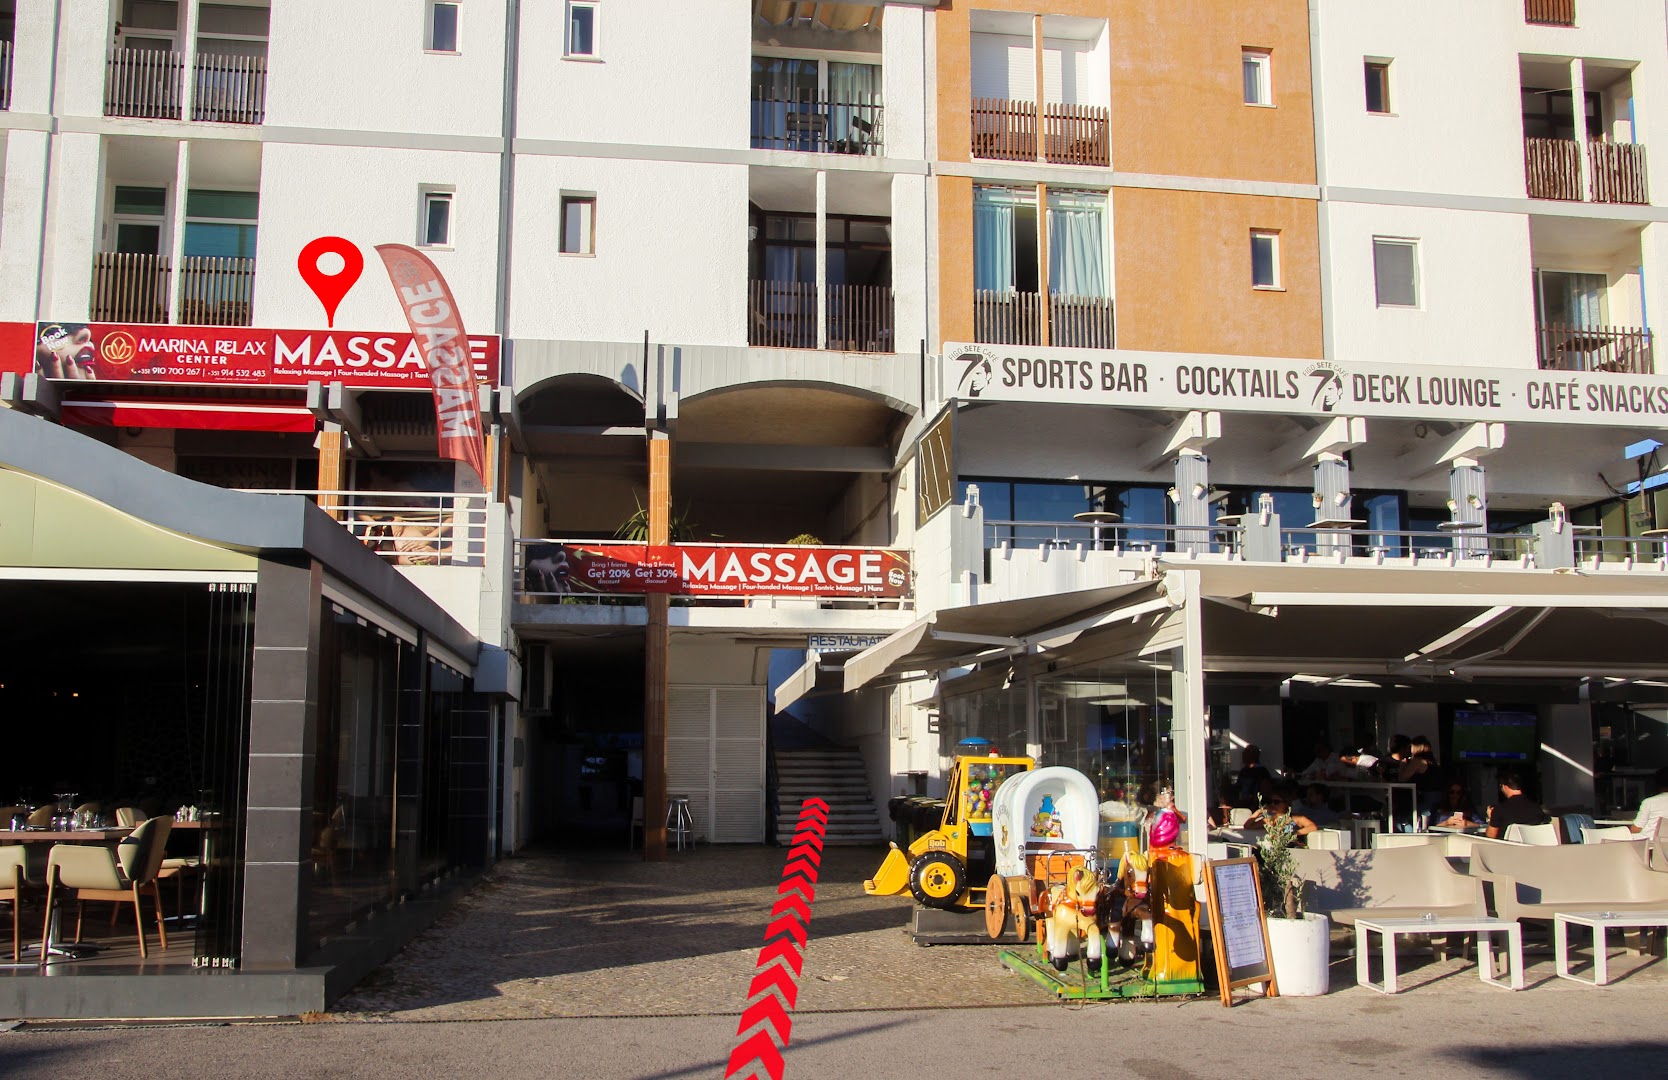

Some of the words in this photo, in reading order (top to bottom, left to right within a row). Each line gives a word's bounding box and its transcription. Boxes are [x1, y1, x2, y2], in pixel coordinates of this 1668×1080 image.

[40, 328, 68, 344] Book
[46, 337, 69, 351] Now
[138, 338, 208, 354] MARINA
[215, 340, 266, 355] RELAX
[274, 333, 488, 371] MASSAE
[177, 354, 227, 364] CENTER
[1316, 361, 1332, 369] SETE
[151, 367, 166, 375] 910
[168, 367, 184, 375] 700
[186, 368, 200, 376] 267
[221, 369, 234, 377] 914
[235, 369, 250, 377] 532
[252, 370, 266, 378] 483
[273, 367, 302, 376] Relaxing
[303, 368, 332, 377] Massage
[338, 369, 378, 377] Four-handed
[380, 371, 409, 379] Massage
[1002, 357, 1093, 390] SPORTS
[1101, 361, 1148, 392] BAR
[1176, 365, 1299, 399] COCKTAILS
[1353, 373, 1411, 404] DECK
[1416, 376, 1502, 408] LOUNGE
[1527, 378, 1580, 411] CAFÉ
[1586, 383, 1668, 415] SNACKS
[588, 568, 606, 578] Get
[609, 569, 630, 578] 20%
[635, 568, 653, 578] Get
[656, 569, 678, 578] 30%
[682, 550, 883, 584] MASSAGE
[682, 582, 709, 590] Relaxing
[710, 583, 737, 591] Massage
[814, 583, 834, 591] Tantric
[836, 584, 863, 592] Massage
[867, 584, 883, 592] Nuru
